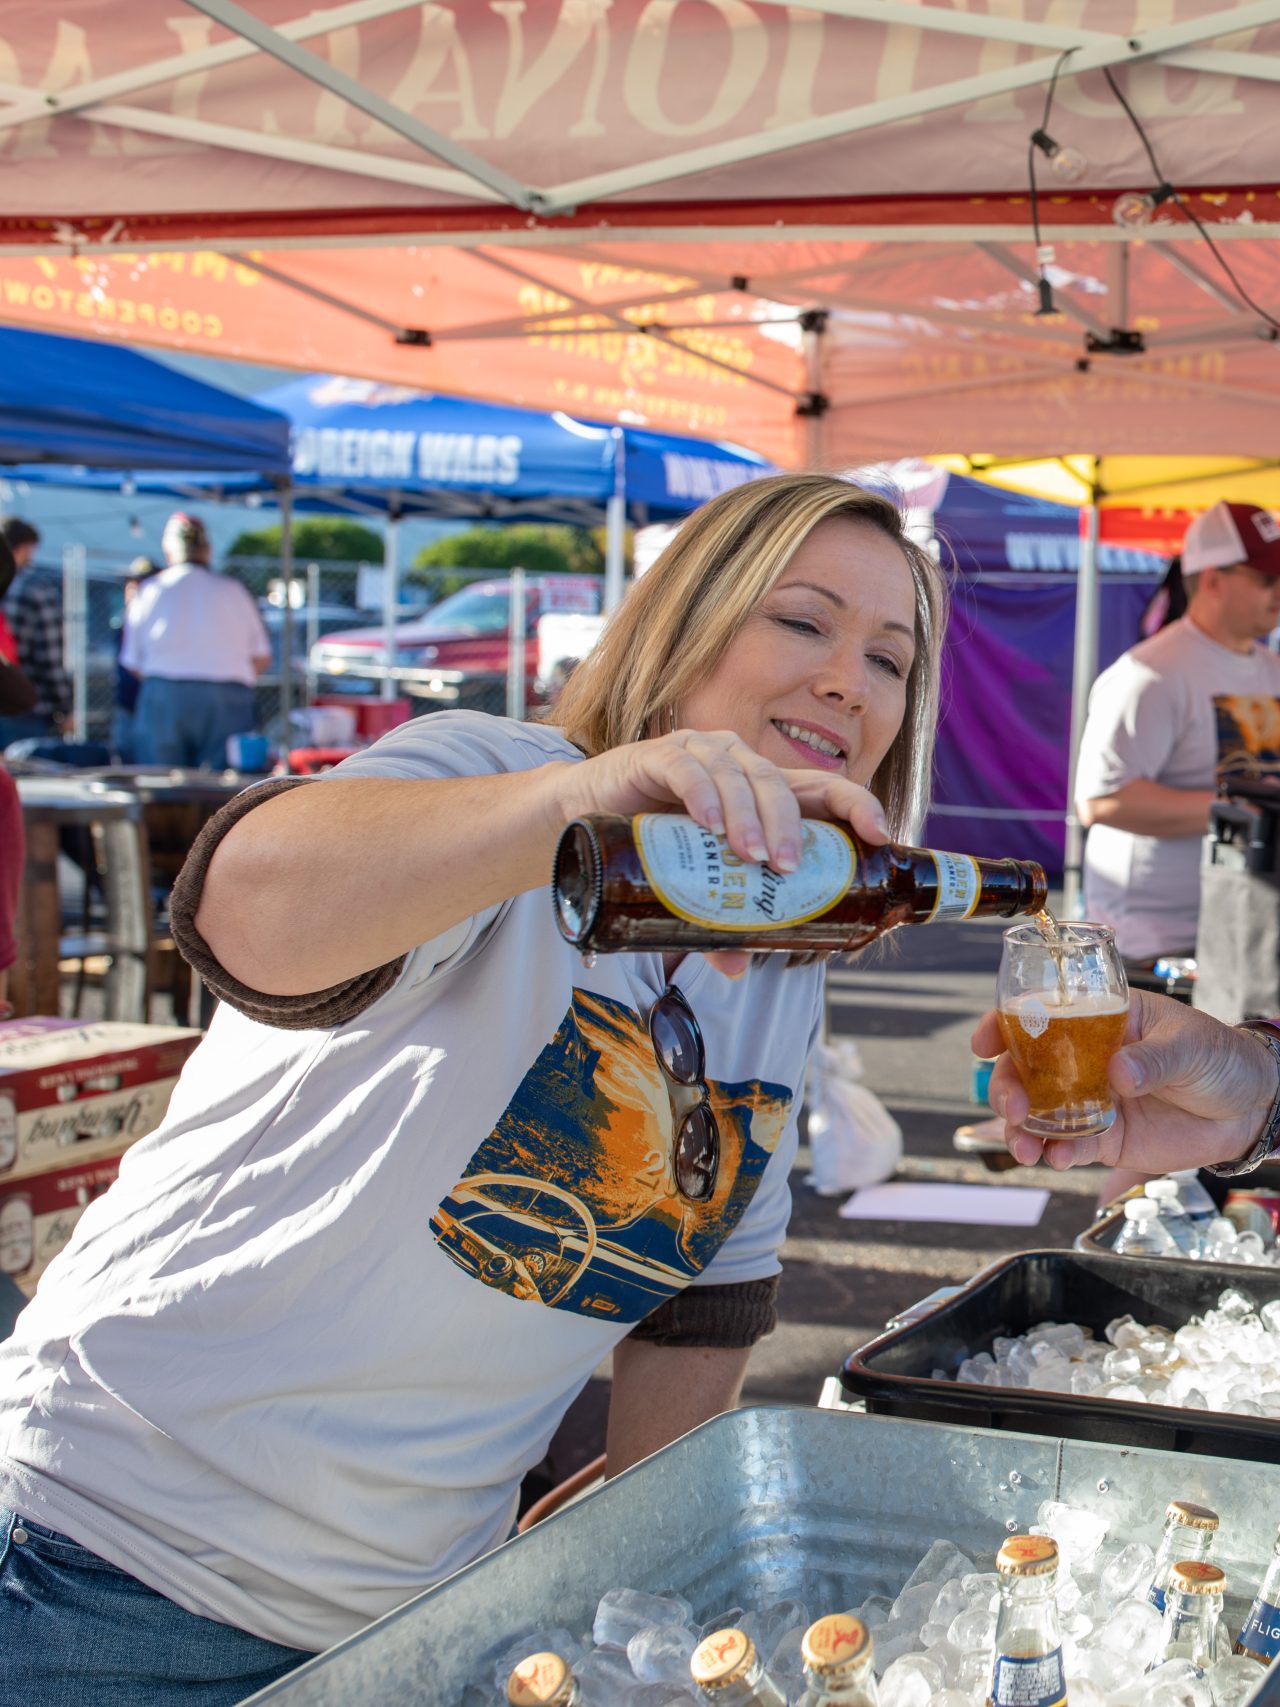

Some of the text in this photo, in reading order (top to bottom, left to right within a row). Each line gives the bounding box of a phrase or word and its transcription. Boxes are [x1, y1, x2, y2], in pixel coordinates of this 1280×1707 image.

[291, 426, 417, 478] OREIGN
[697, 825, 721, 885] ILSNER
[719, 834, 748, 910] DEN
